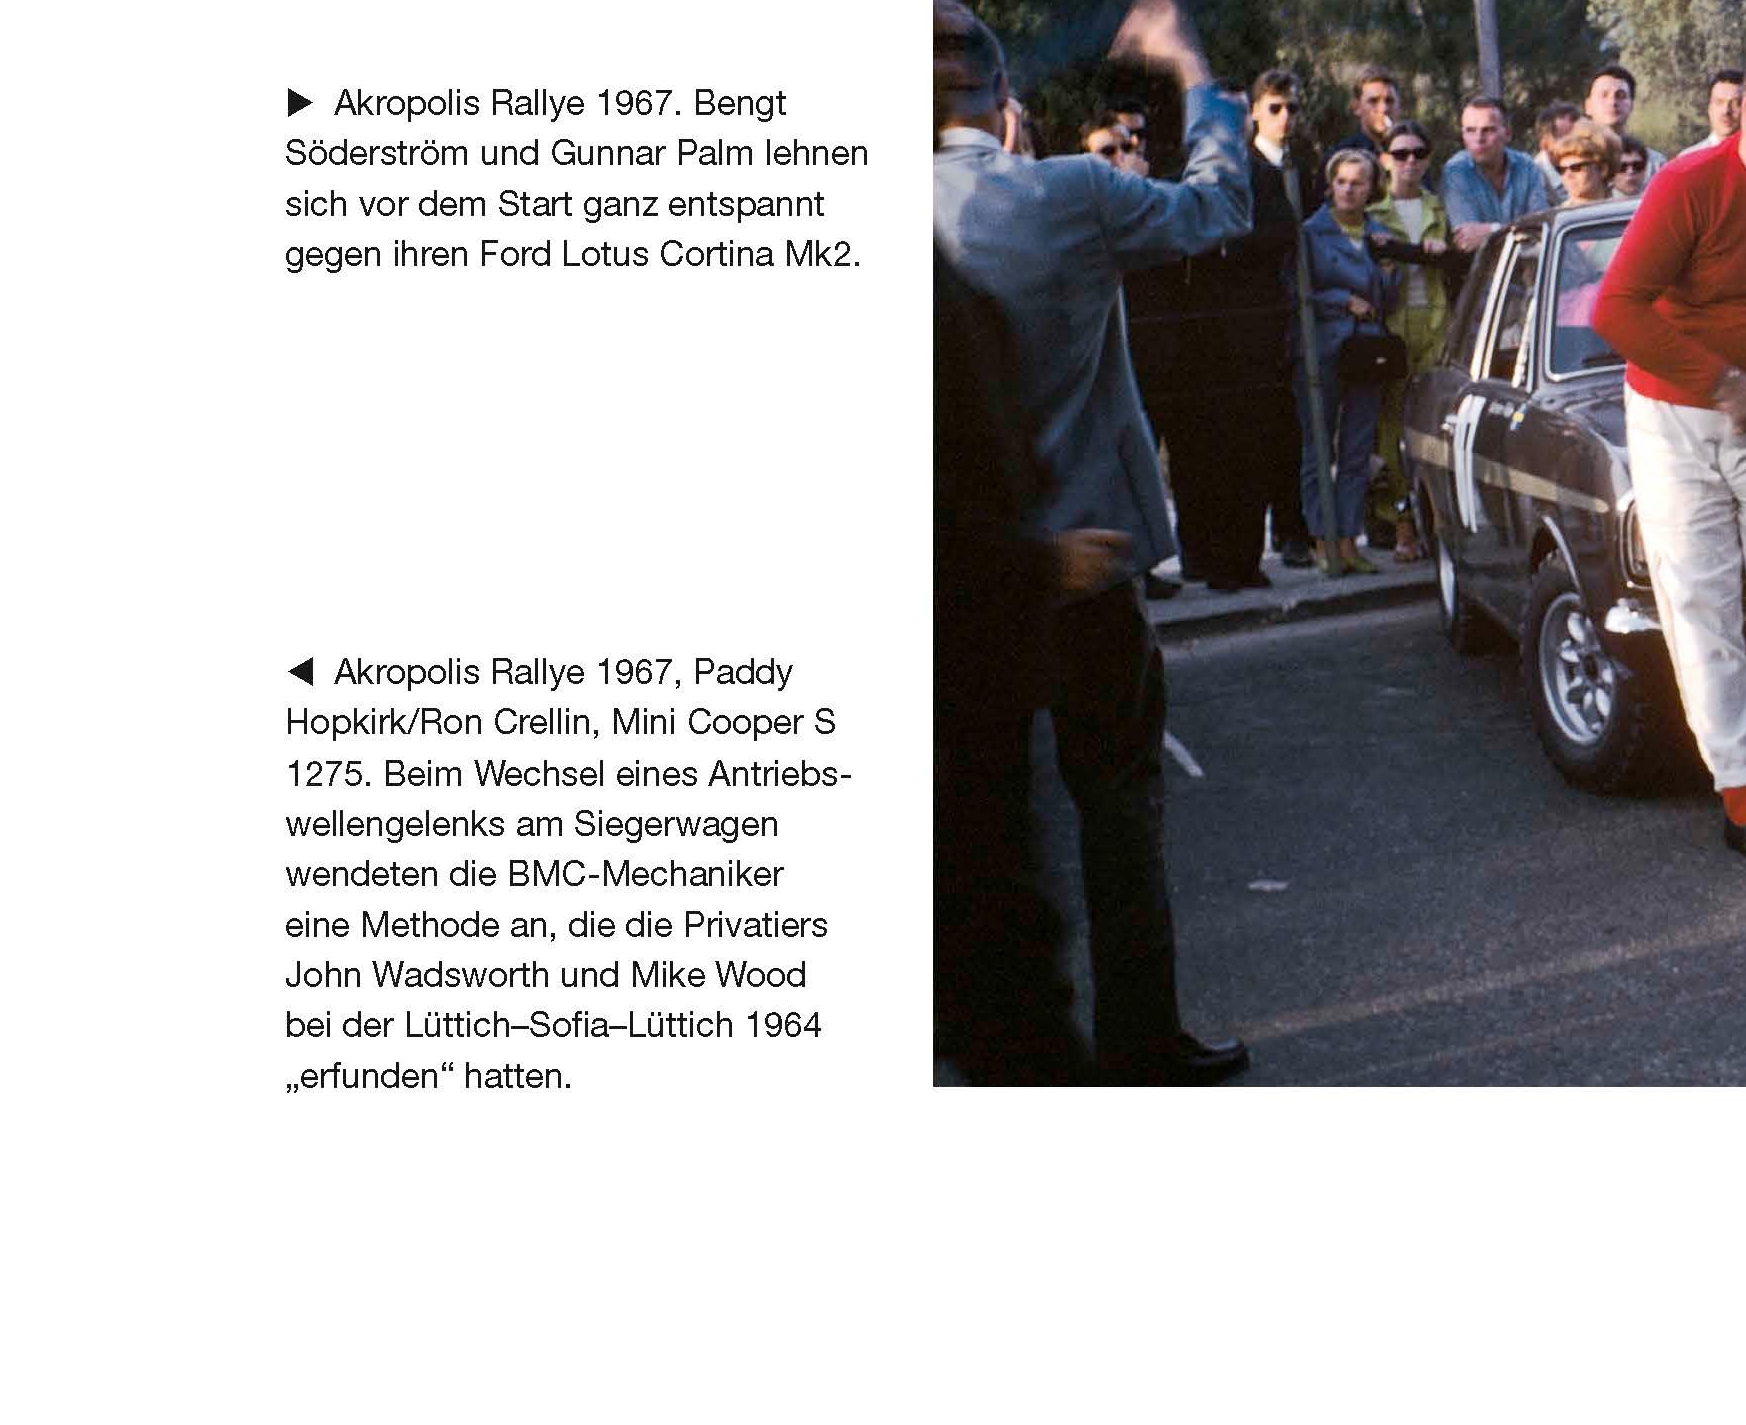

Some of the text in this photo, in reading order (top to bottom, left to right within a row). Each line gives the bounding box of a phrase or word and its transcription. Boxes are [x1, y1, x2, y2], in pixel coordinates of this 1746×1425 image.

[333, 88, 787, 123] Akropolis Rallye 1967. Bengt
[285, 138, 868, 166] Söderström und Gunnar Palm lehnen
[285, 189, 825, 224] sich vor dem Start ganz entspannt
[285, 239, 860, 274] gegen ihren Ford Lotus Cortina Mk2.
[333, 657, 794, 692] Akropolis Rallye 1967, Paddy
[287, 707, 836, 742] Hopkirk/Ron Crellin, Mini Cooper S
[288, 759, 852, 787] 1275. Beim Wechsel eines Antriebs-
[285, 809, 778, 844] wellengelenks am Siegerwagen
[285, 859, 785, 887] wendeten die BMC-Mechaniker
[285, 910, 828, 943] eine Methode an, die die Privatiers
[285, 960, 806, 988] John Wadsworth und Mike Wood
[286, 1010, 822, 1038] bei der Lüttich–Sofia–Lüttich 1964
[286, 1061, 571, 1094] „erfunden“ hatten.
